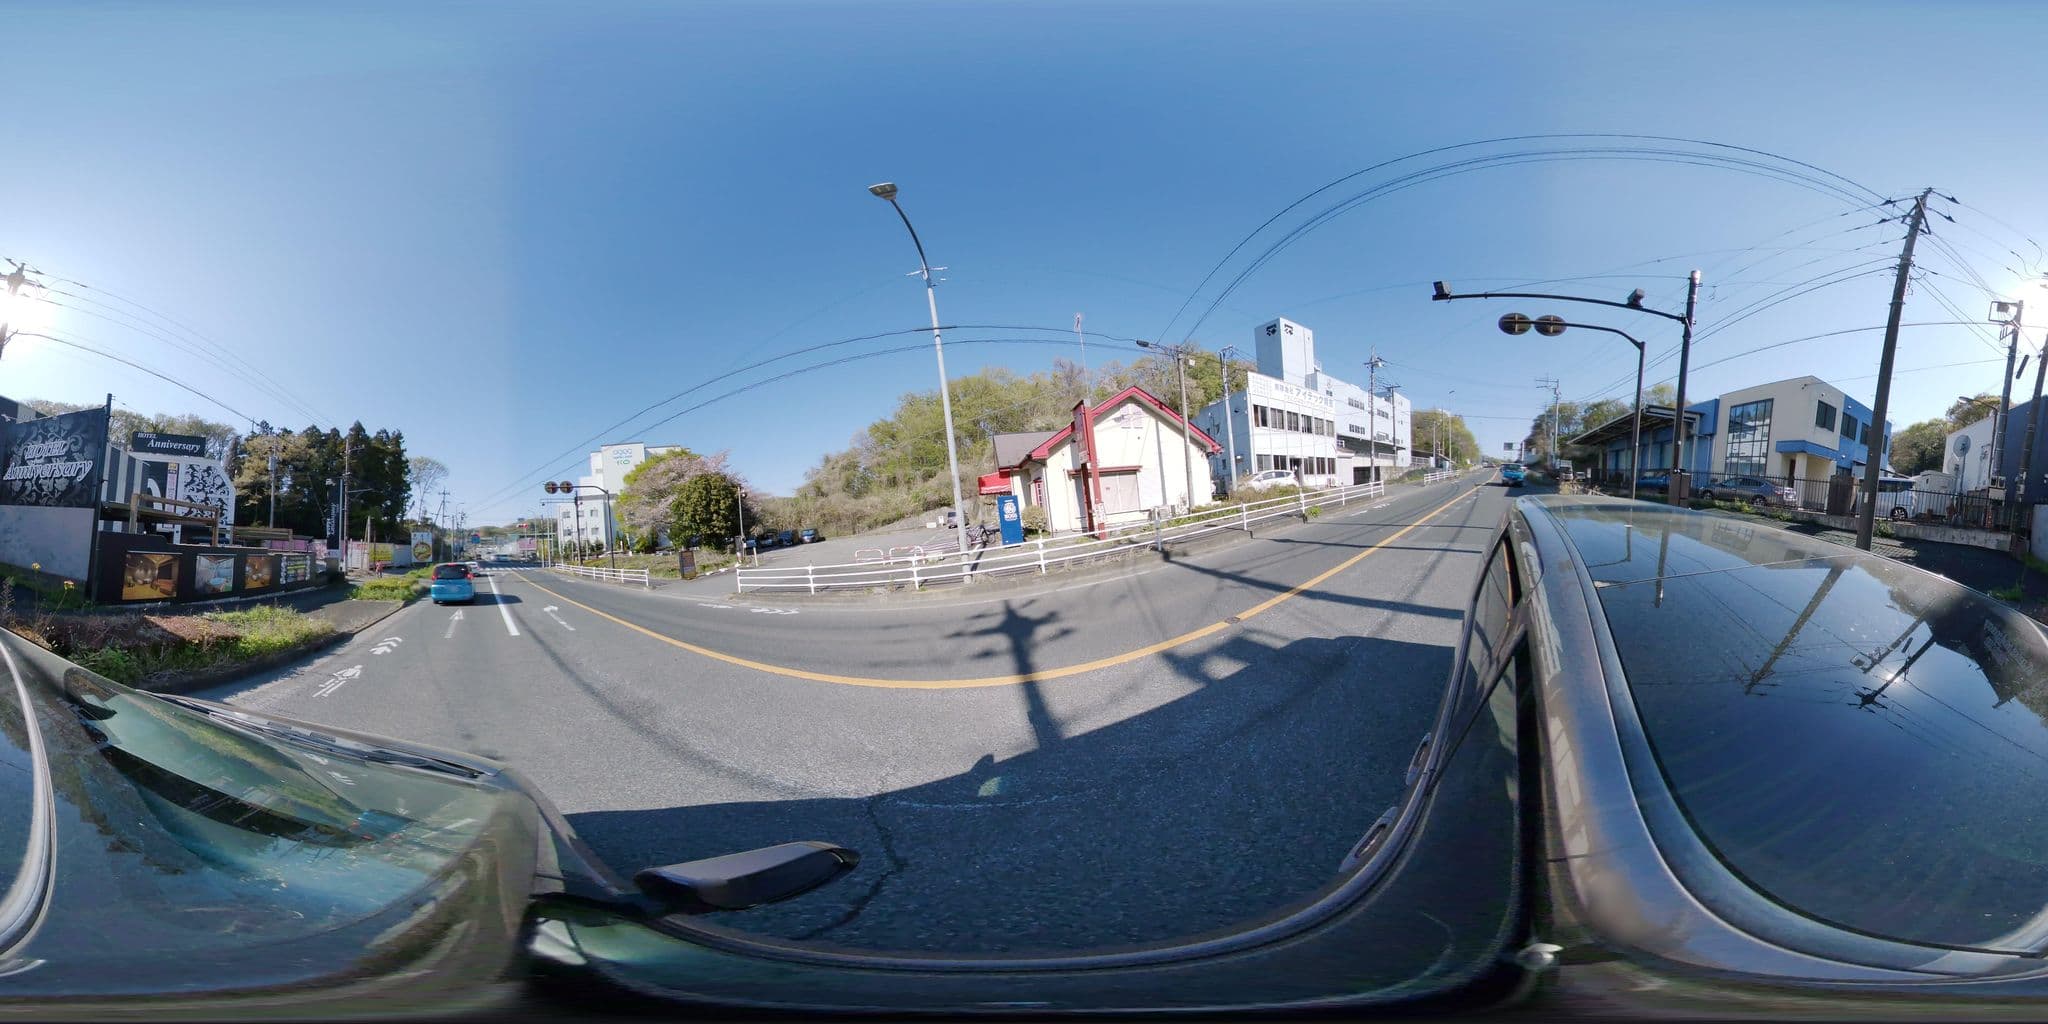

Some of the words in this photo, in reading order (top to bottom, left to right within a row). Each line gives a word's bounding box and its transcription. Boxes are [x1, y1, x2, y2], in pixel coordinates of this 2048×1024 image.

[24, 440, 69, 461] HOTEL
[147, 439, 201, 453] Anniversary
[3, 461, 93, 482] Anniversary
